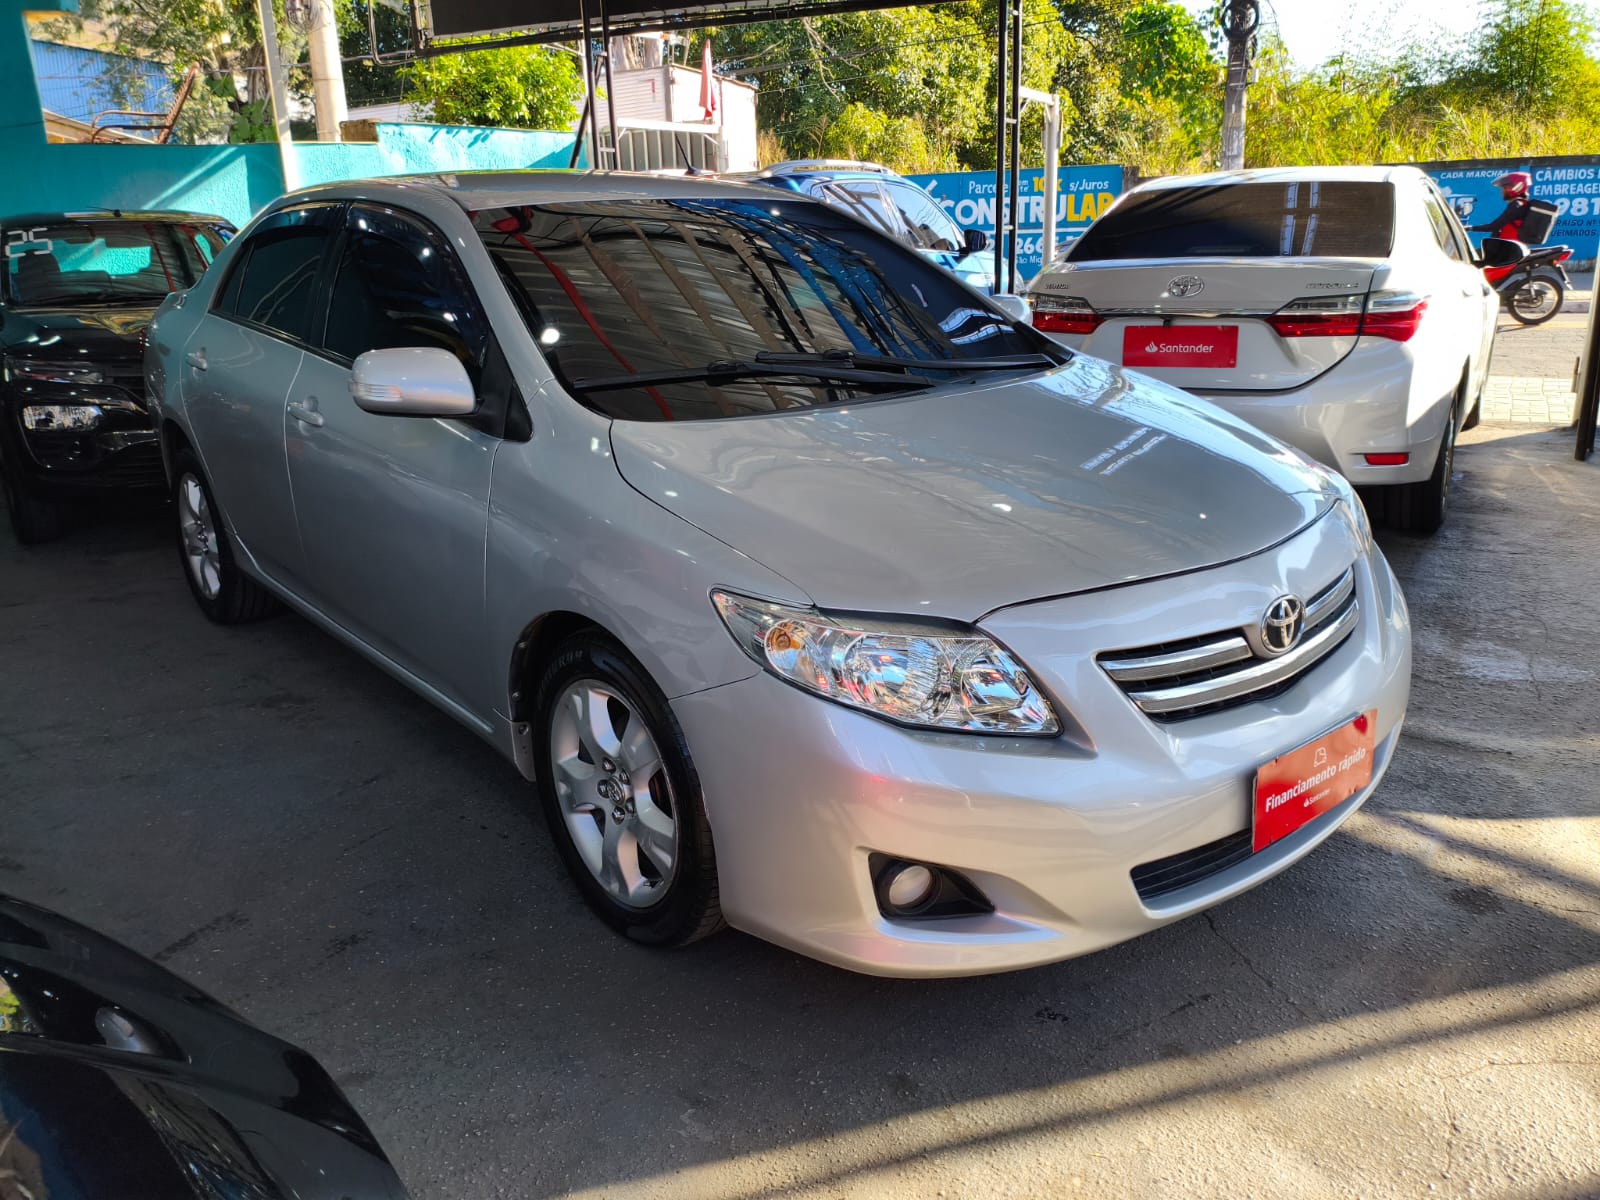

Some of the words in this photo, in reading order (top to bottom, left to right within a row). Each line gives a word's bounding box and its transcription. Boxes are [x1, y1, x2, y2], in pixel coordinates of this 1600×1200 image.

[1440, 171, 1464, 179] CADA
[1535, 167, 1595, 182] CÂMBIOS
[968, 180, 1009, 194] Parce
[1069, 178, 1110, 192] s/Juros
[1533, 183, 1600, 196] EMBREAGE
[1551, 228, 1597, 237] UEIMADOS
[5, 227, 53, 258] 25
[1159, 343, 1215, 354] Santander
[1265, 765, 1337, 813] Financiamento
[1338, 746, 1366, 774] rápido
